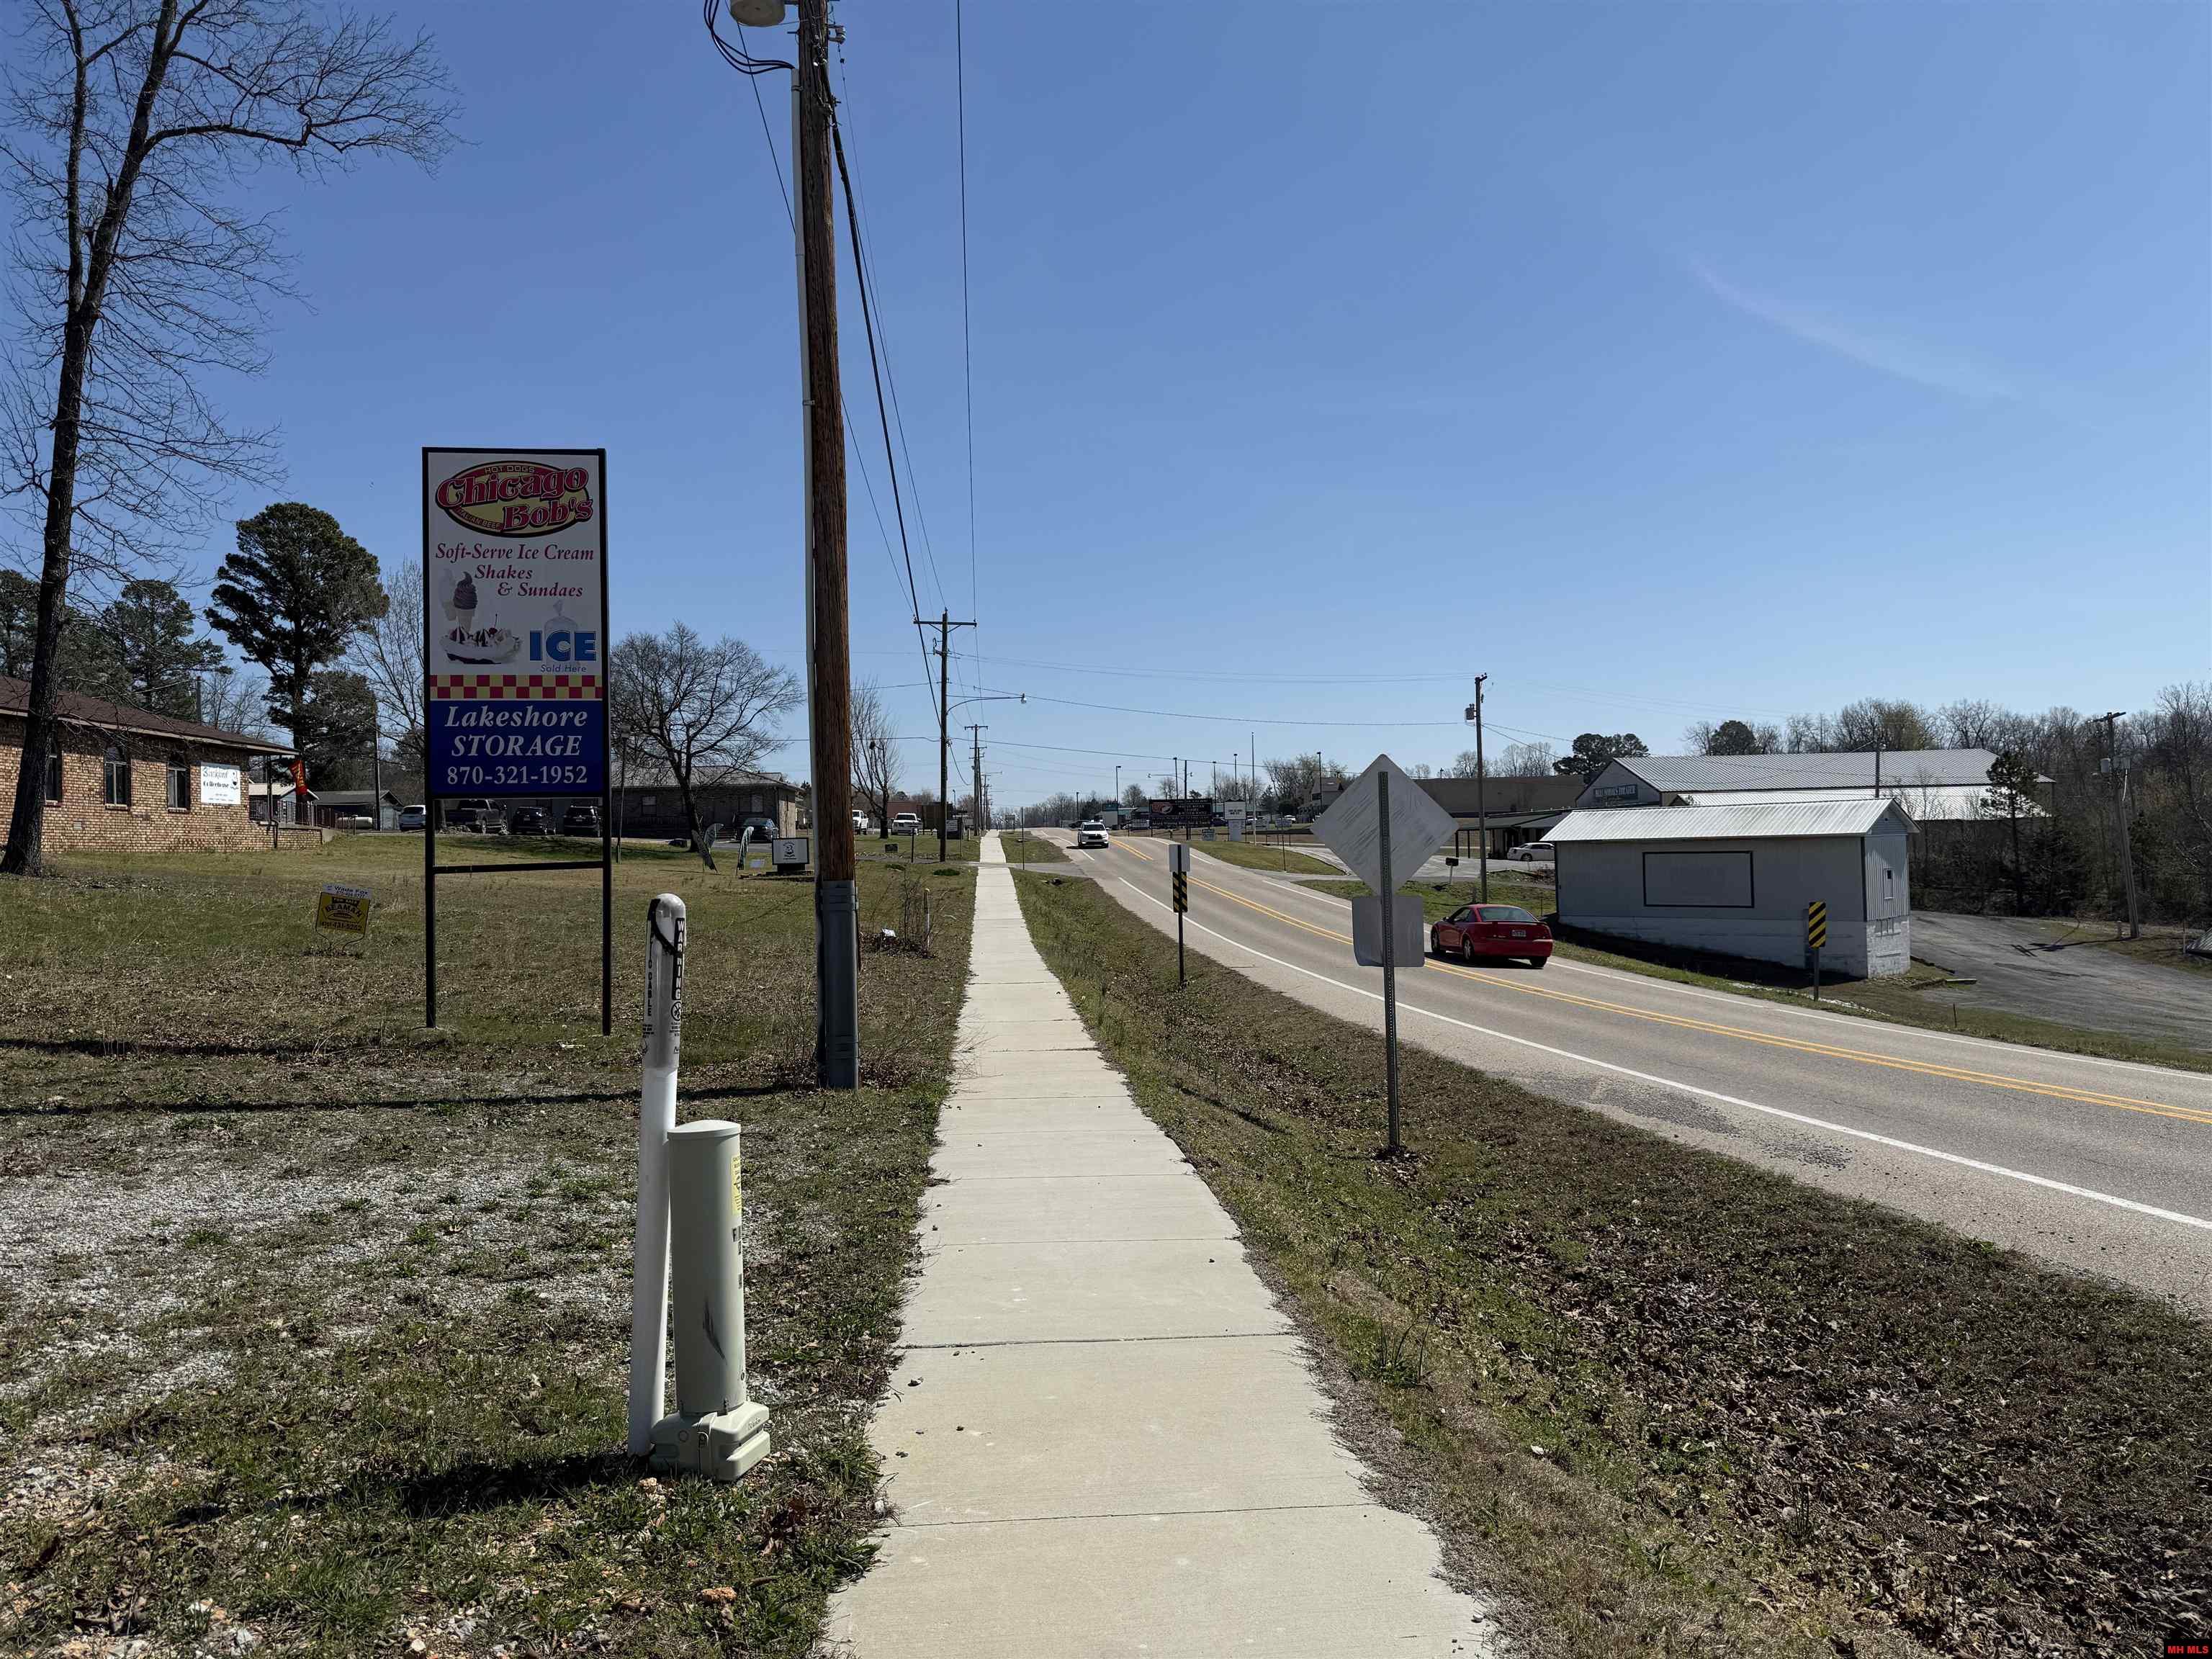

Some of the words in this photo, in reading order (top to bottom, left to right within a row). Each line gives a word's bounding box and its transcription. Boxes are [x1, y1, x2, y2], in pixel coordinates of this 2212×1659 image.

[435, 467, 589, 508] Chicago
[501, 497, 593, 531] Bob's
[436, 543, 513, 563] Soft-Serve
[517, 544, 539, 559] Ice
[544, 544, 594, 560] Cream
[475, 565, 533, 579] Shakes
[498, 582, 513, 596] &
[518, 582, 583, 597] Sundaes
[529, 630, 597, 662] ICE
[541, 664, 560, 673] Sold
[444, 705, 588, 727] Lakeshore
[451, 734, 583, 756] STORAGE
[447, 765, 588, 784] 870-321-1952
[675, 920, 684, 999] WARNING
